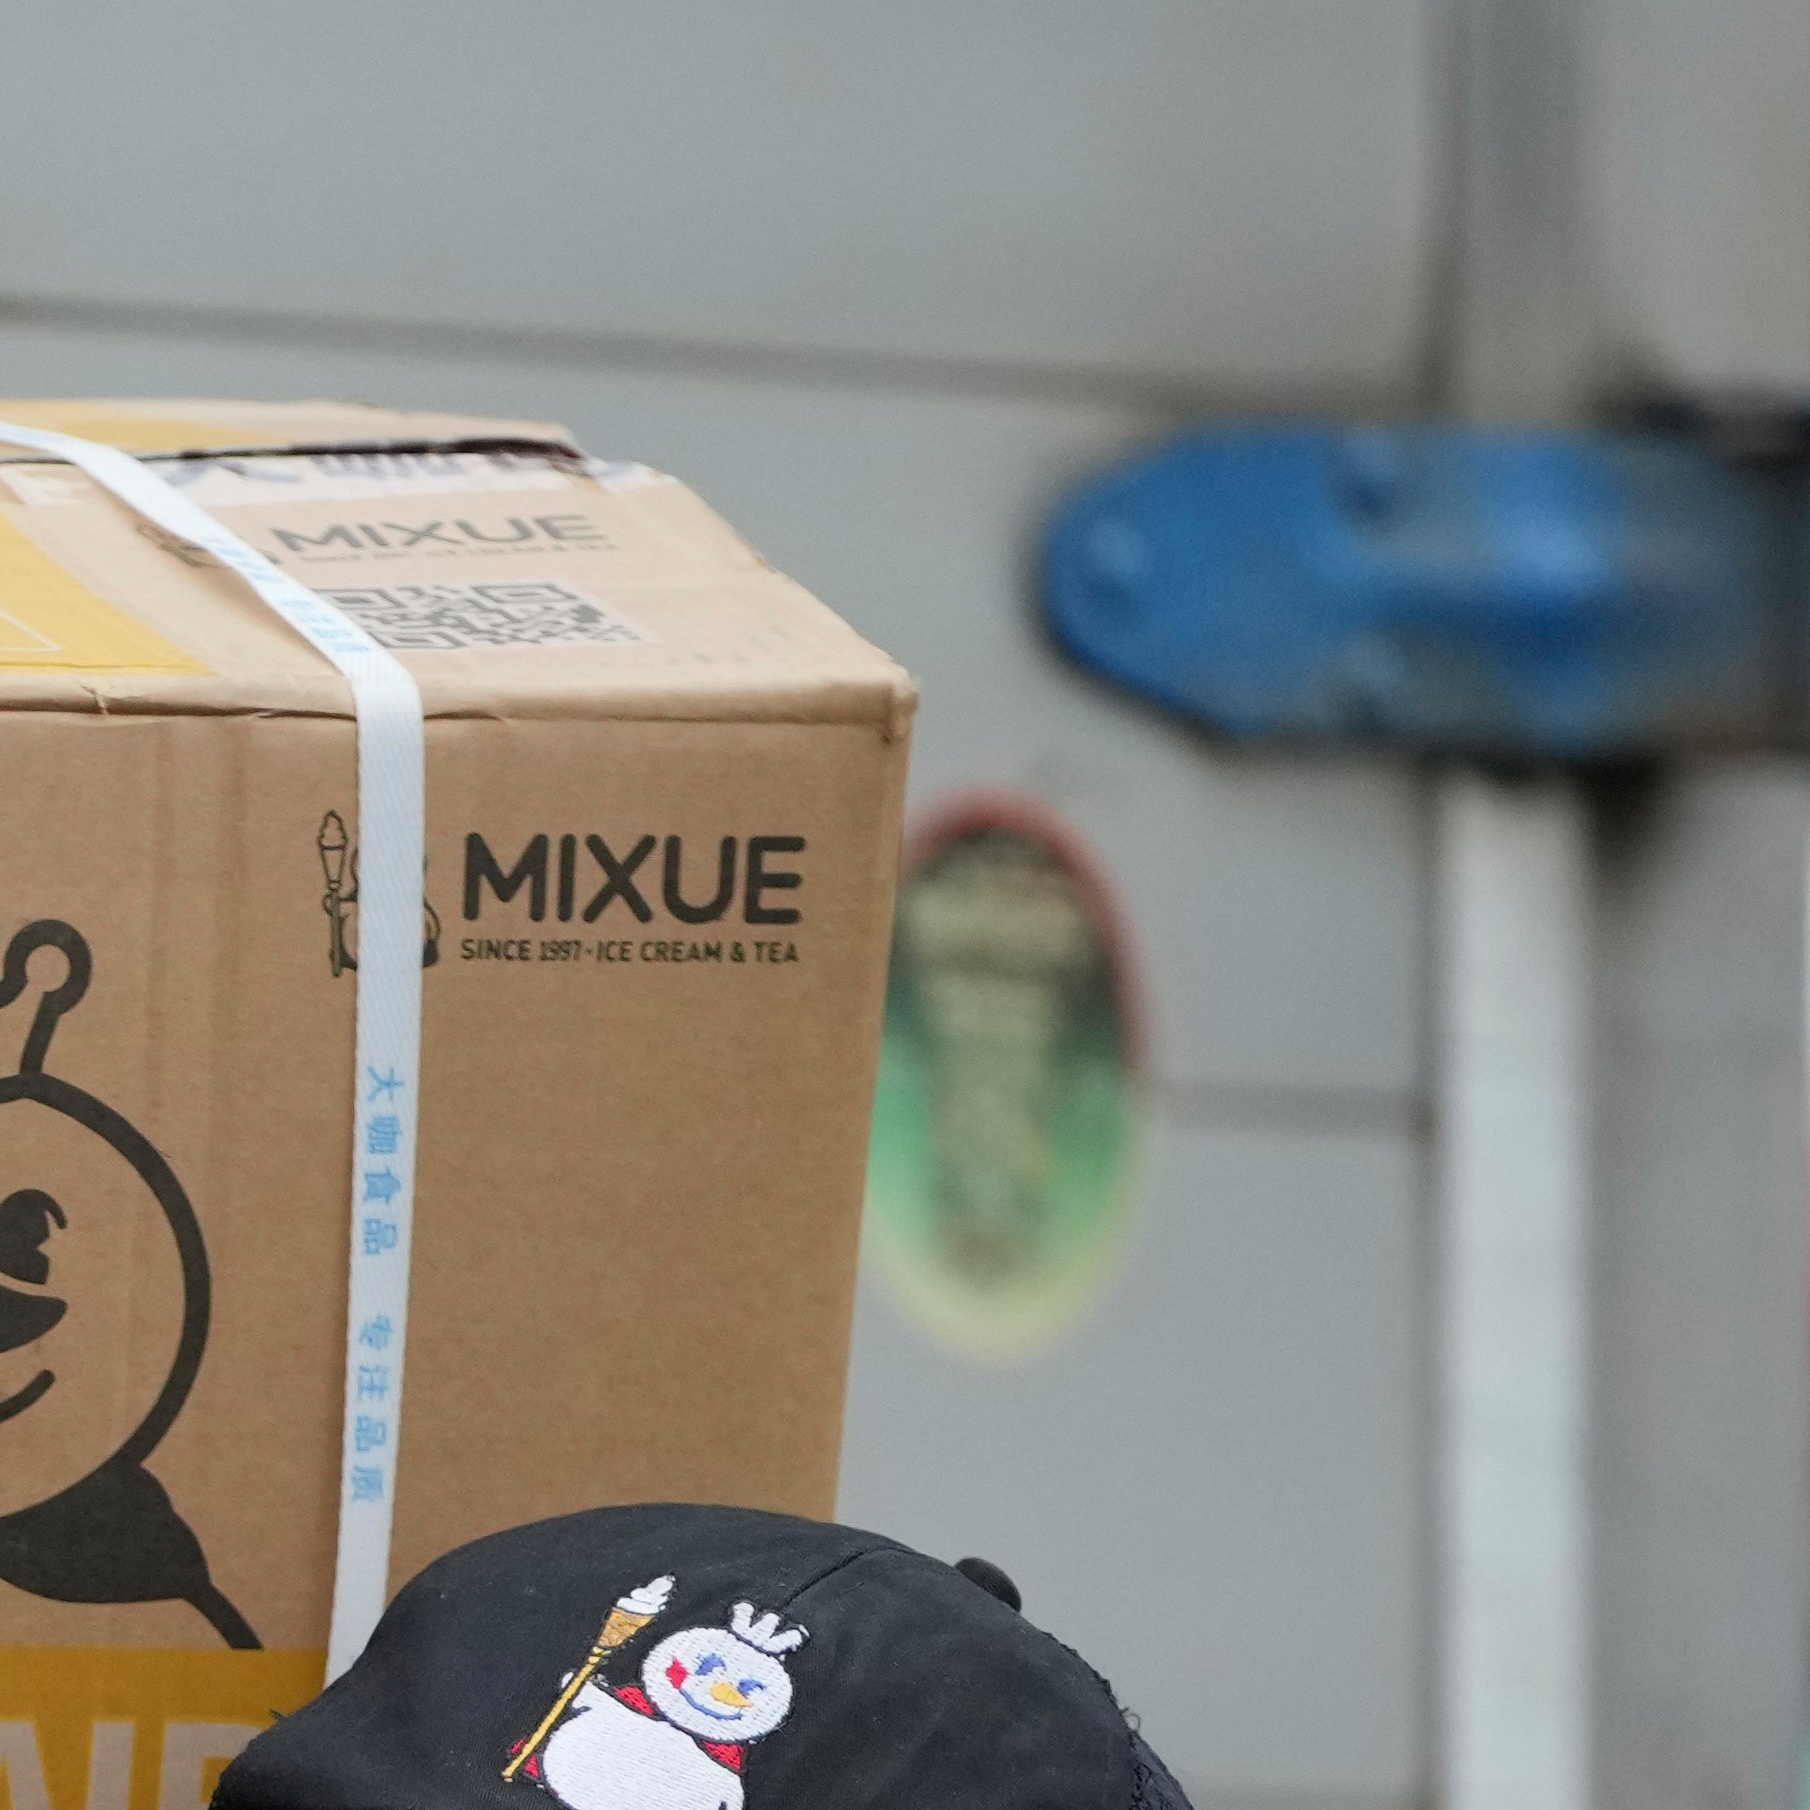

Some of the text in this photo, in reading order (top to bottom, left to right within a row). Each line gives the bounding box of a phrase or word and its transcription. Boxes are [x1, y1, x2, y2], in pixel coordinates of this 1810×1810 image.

[268, 513, 609, 552] MIXUE
[463, 832, 807, 924] MIXUE
[460, 938, 532, 962] SINCE
[640, 940, 723, 963] CREAM
[730, 941, 747, 963] &
[753, 942, 800, 963] TEA
